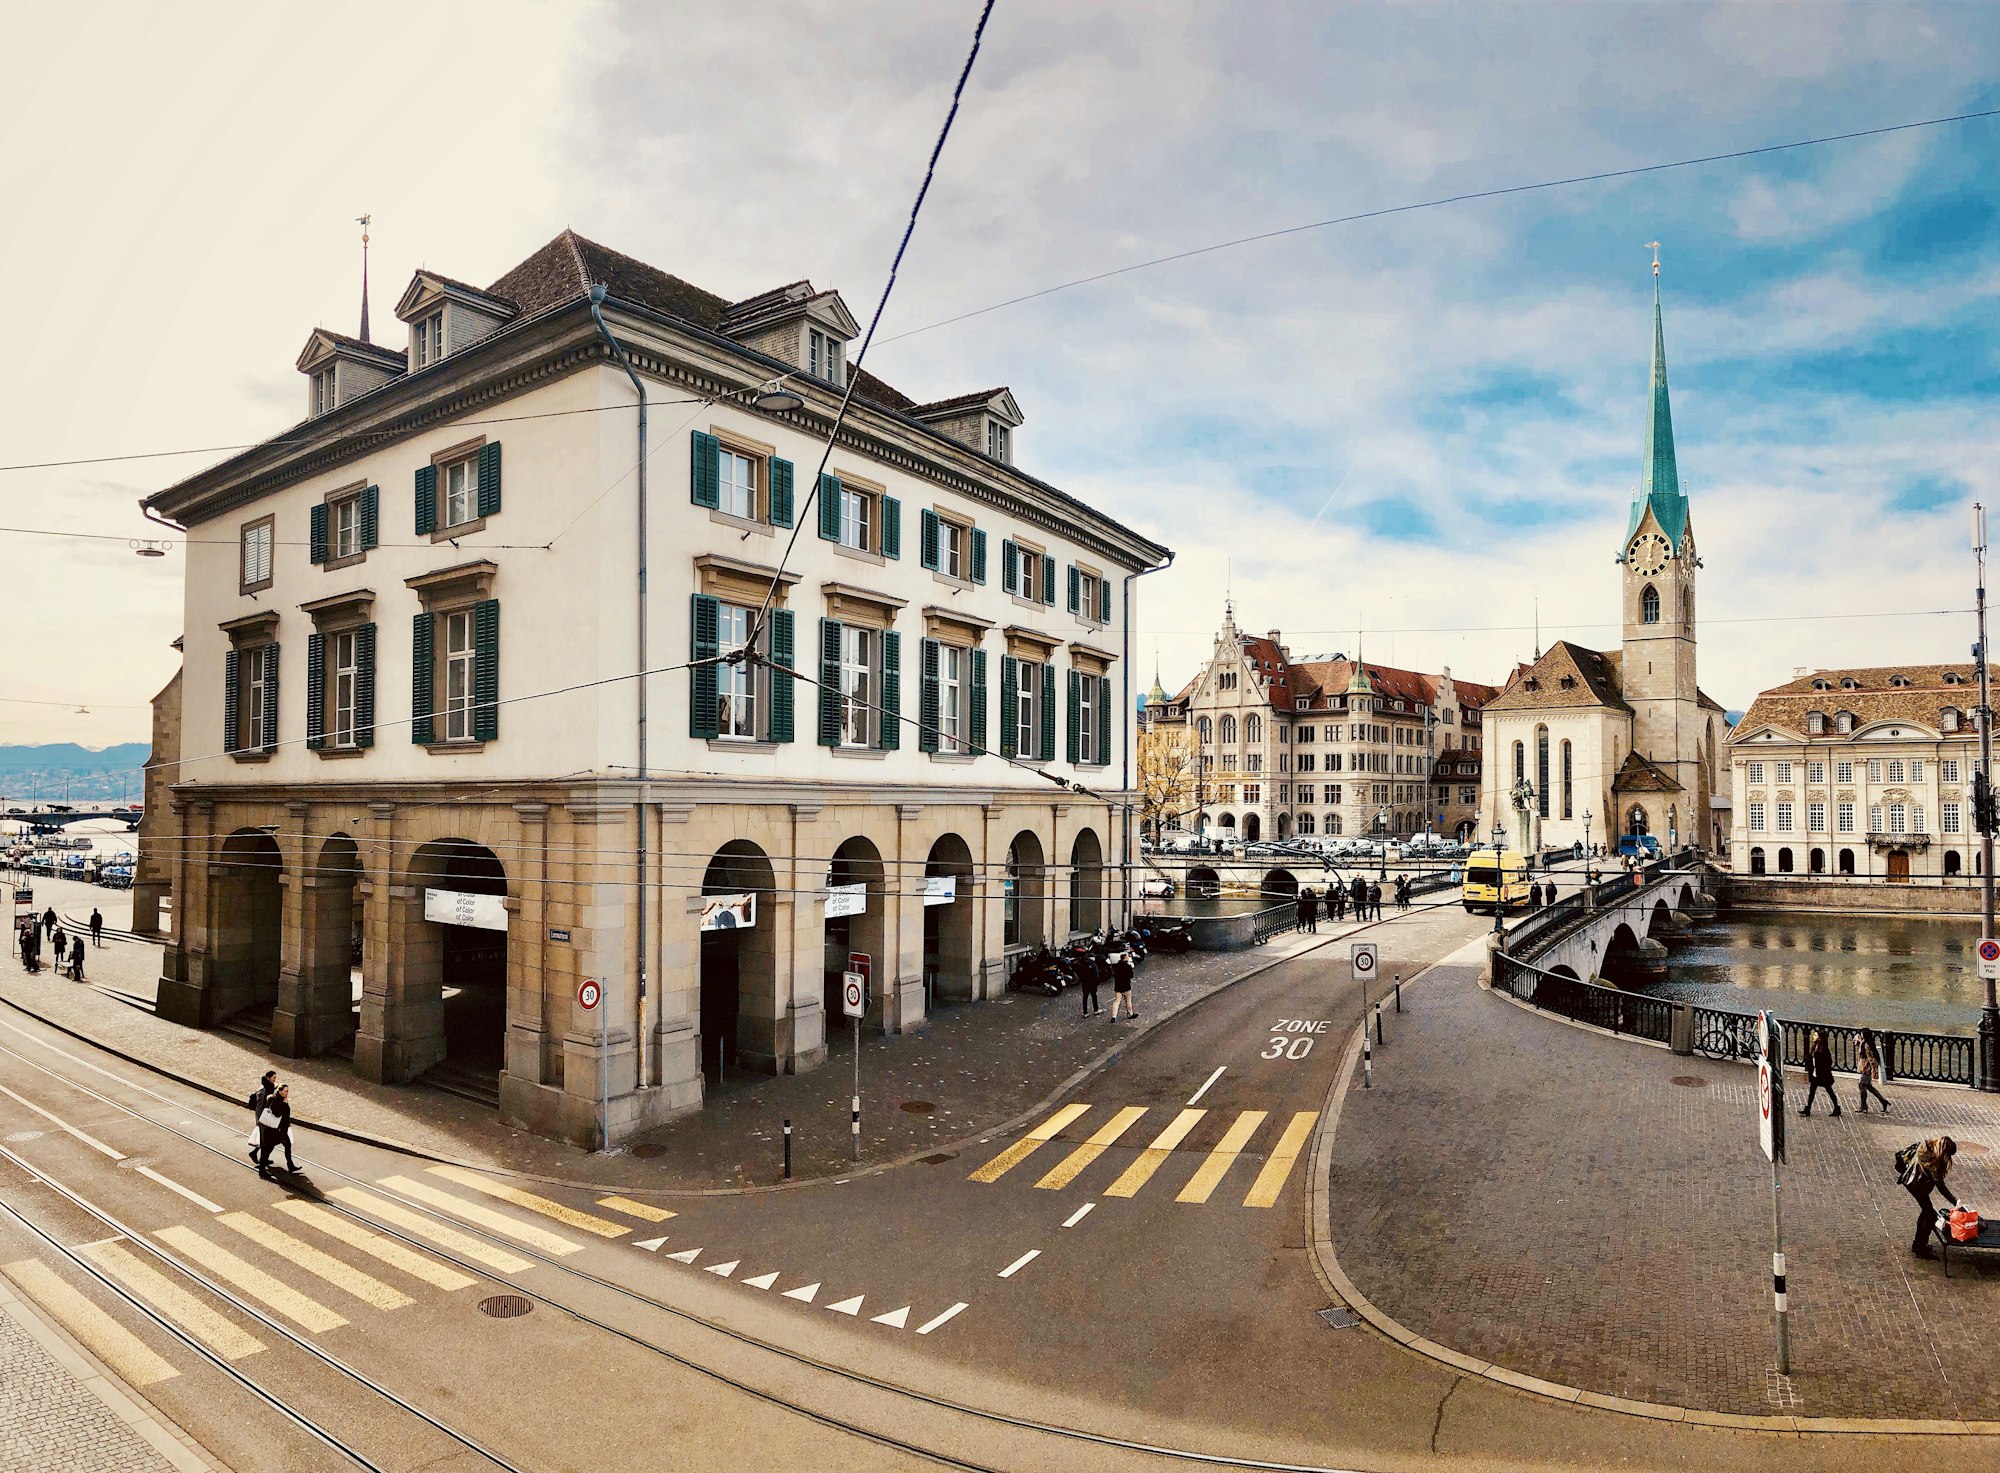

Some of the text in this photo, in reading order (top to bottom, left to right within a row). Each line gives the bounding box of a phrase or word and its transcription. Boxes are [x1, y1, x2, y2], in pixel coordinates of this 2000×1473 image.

[1360, 957, 1369, 966] 30
[585, 990, 595, 1001] 30
[1270, 1019, 1332, 1034] ZONE
[1260, 1036, 1315, 1060] 30
